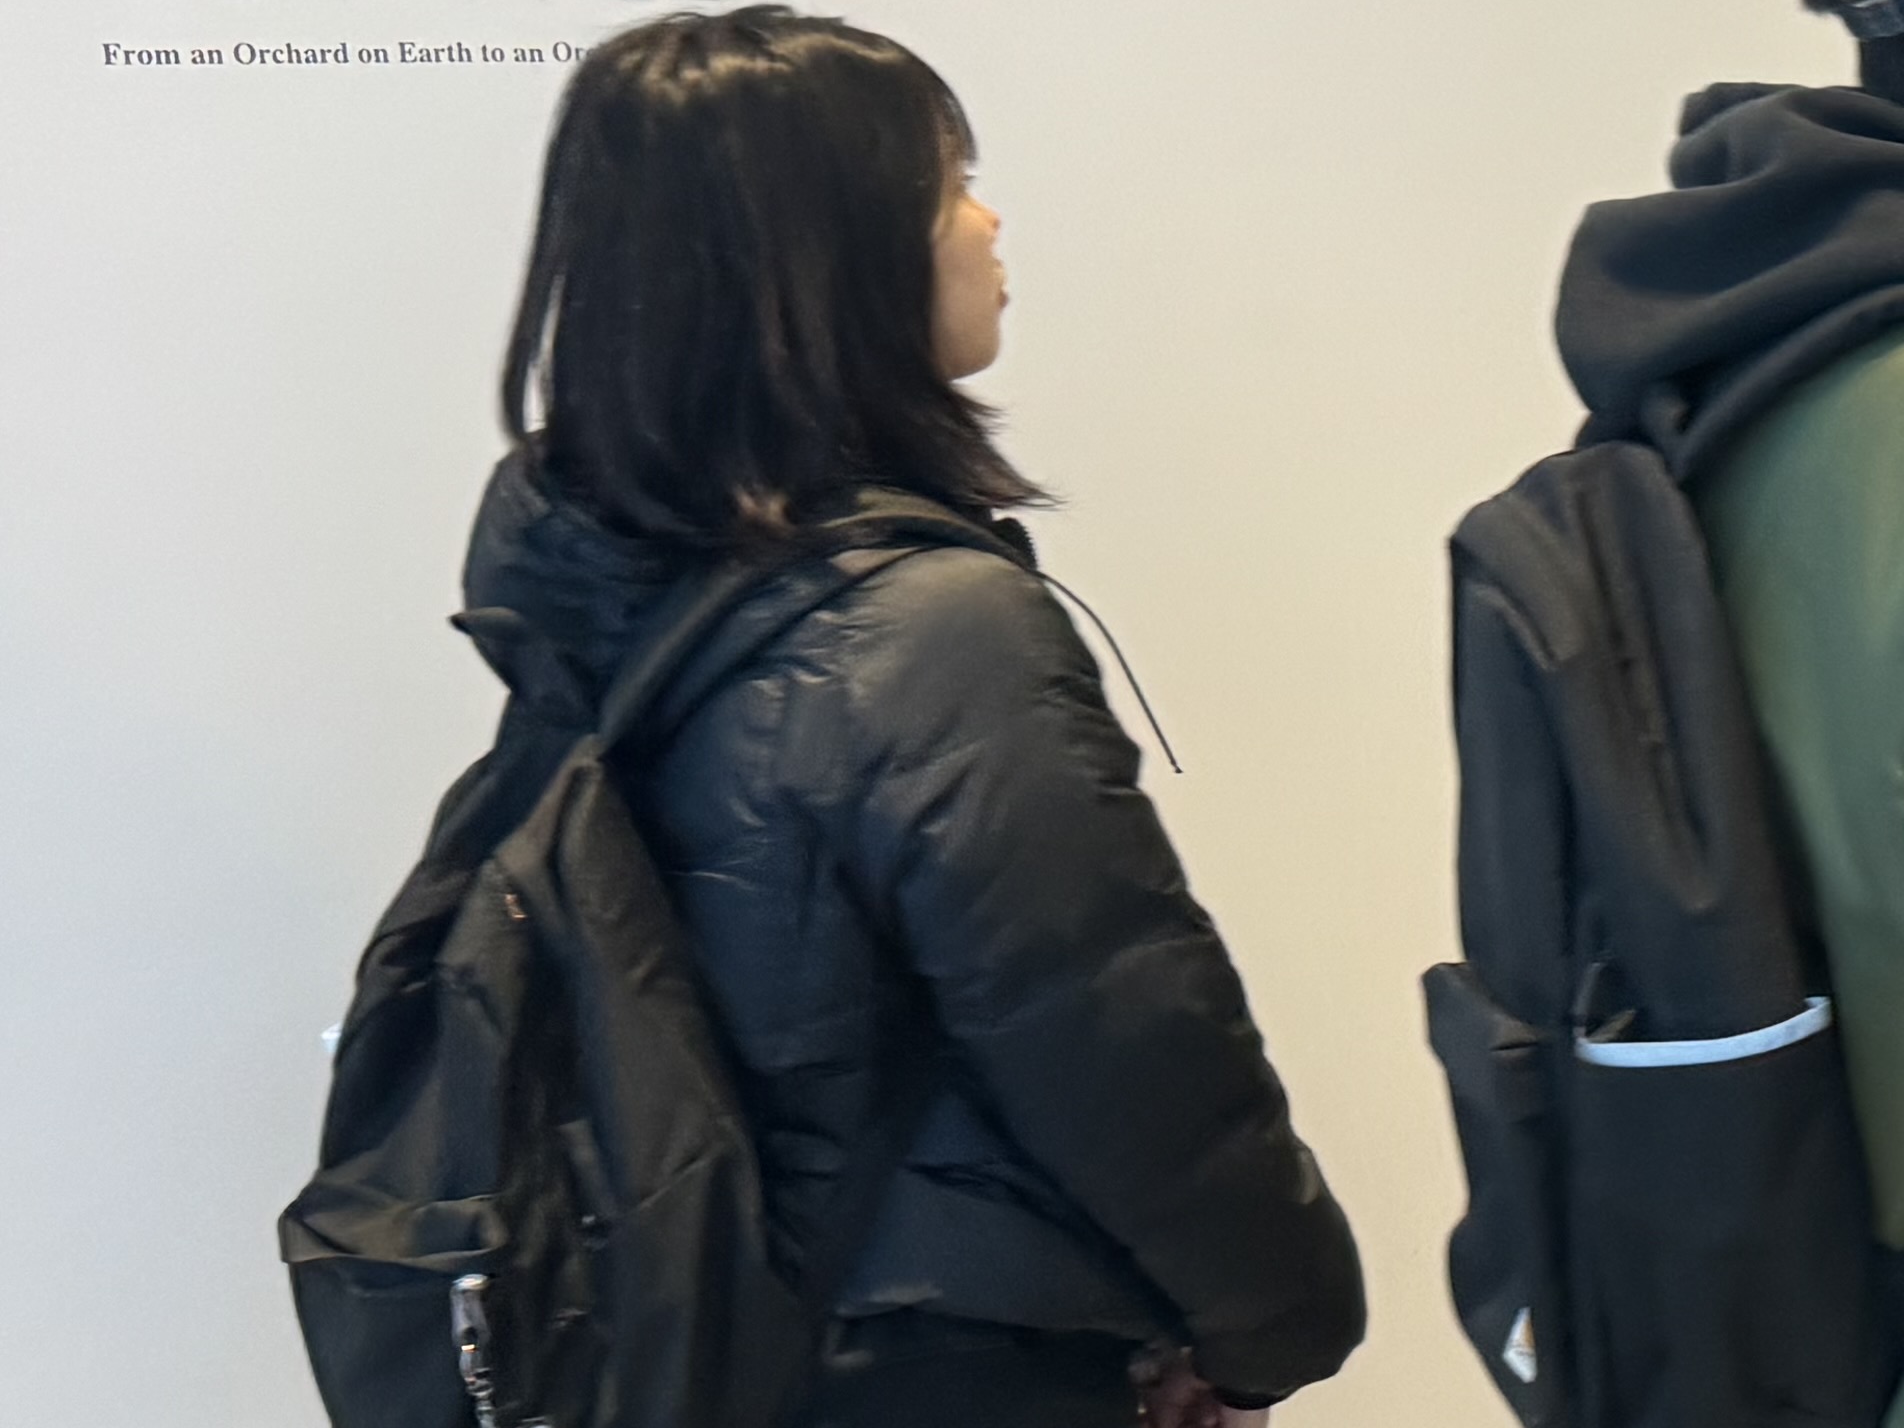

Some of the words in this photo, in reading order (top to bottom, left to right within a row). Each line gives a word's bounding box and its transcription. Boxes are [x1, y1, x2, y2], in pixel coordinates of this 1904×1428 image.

[102, 42, 181, 66] From
[190, 47, 224, 65] an
[233, 41, 349, 65] Orchard
[358, 46, 390, 64] on
[399, 40, 473, 63] Earth
[482, 44, 505, 63] to
[513, 44, 545, 62] an
